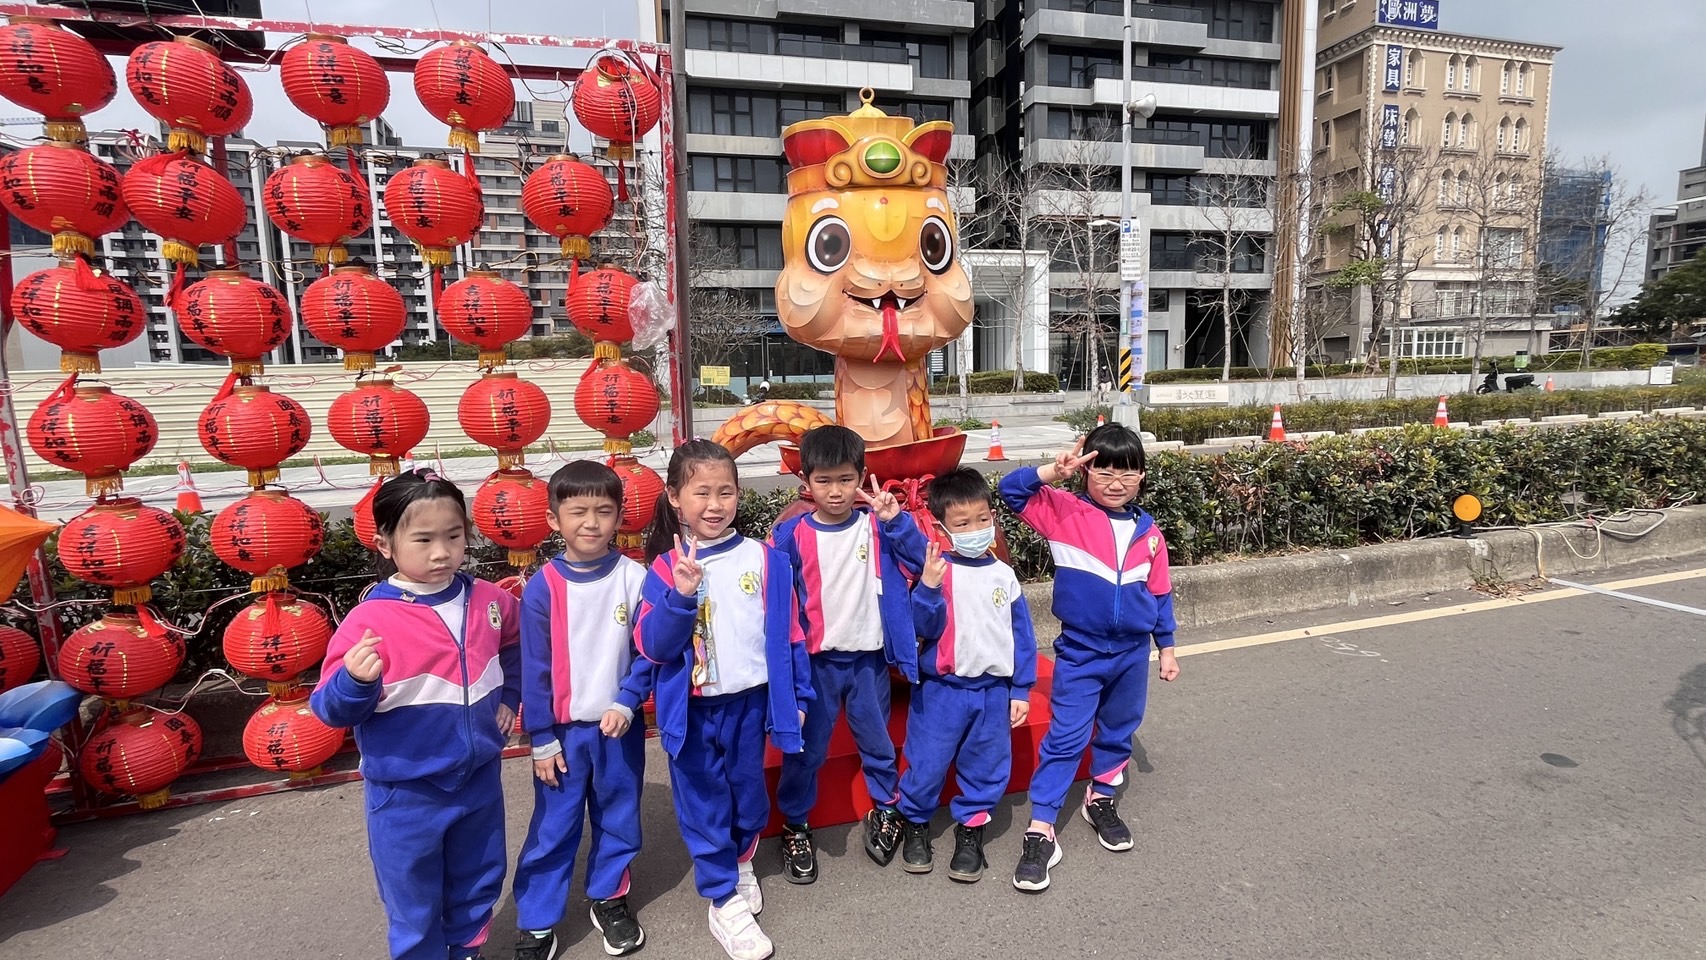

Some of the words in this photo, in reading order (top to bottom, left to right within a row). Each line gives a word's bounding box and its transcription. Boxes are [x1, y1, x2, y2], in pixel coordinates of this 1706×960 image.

[1388, 0, 1435, 24] 歐洲夢
[316, 43, 349, 104] 吉祥如意
[452, 49, 476, 107] 祈福平安
[1387, 48, 1401, 87] 家具
[172, 160, 204, 222] 祈福平安
[271, 169, 304, 232] 祈福平安
[408, 169, 434, 229] 祈福平安
[548, 163, 577, 217] 祈福平安
[186, 285, 224, 347] 祈福平安
[257, 286, 287, 346] 國泰民安
[332, 279, 360, 339] 祈福平安
[463, 284, 490, 337] 吉祥如意
[597, 273, 614, 325] 祈福平安
[361, 395, 389, 449] 祈福平安
[497, 388, 521, 442] 祈福平安
[602, 373, 622, 424] 祈福平安
[40, 403, 79, 462] 吉祥如意
[204, 402, 231, 461] 祈福平安
[229, 504, 255, 561] 吉祥如意
